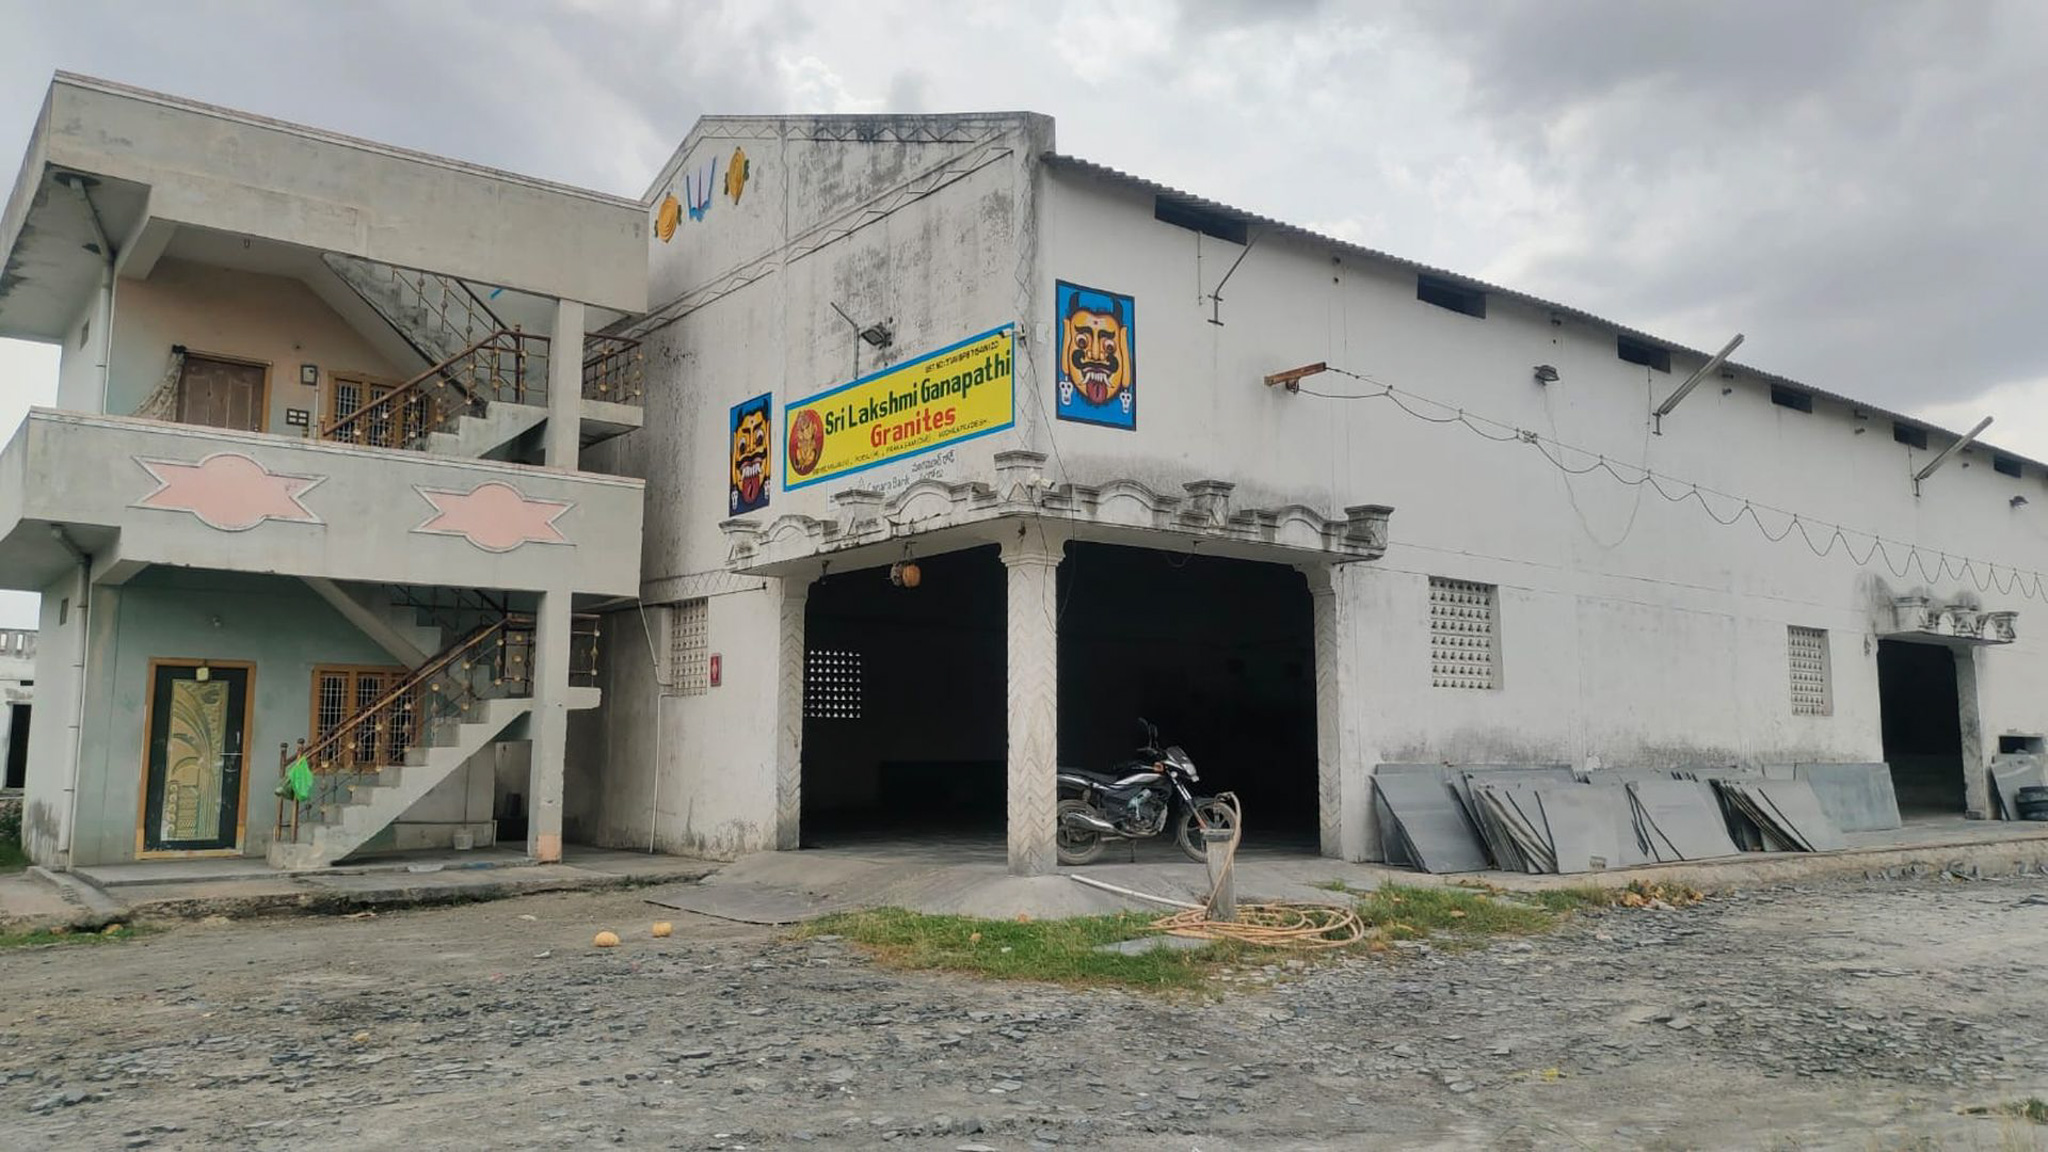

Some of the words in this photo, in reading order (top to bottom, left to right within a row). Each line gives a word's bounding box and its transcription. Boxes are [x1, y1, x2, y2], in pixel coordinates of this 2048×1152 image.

[825, 407, 845, 436] Sri
[849, 382, 918, 428] Lakshmi
[921, 350, 1011, 399] Ganapathi
[870, 406, 957, 448] Granites
[892, 474, 911, 489] Bank
